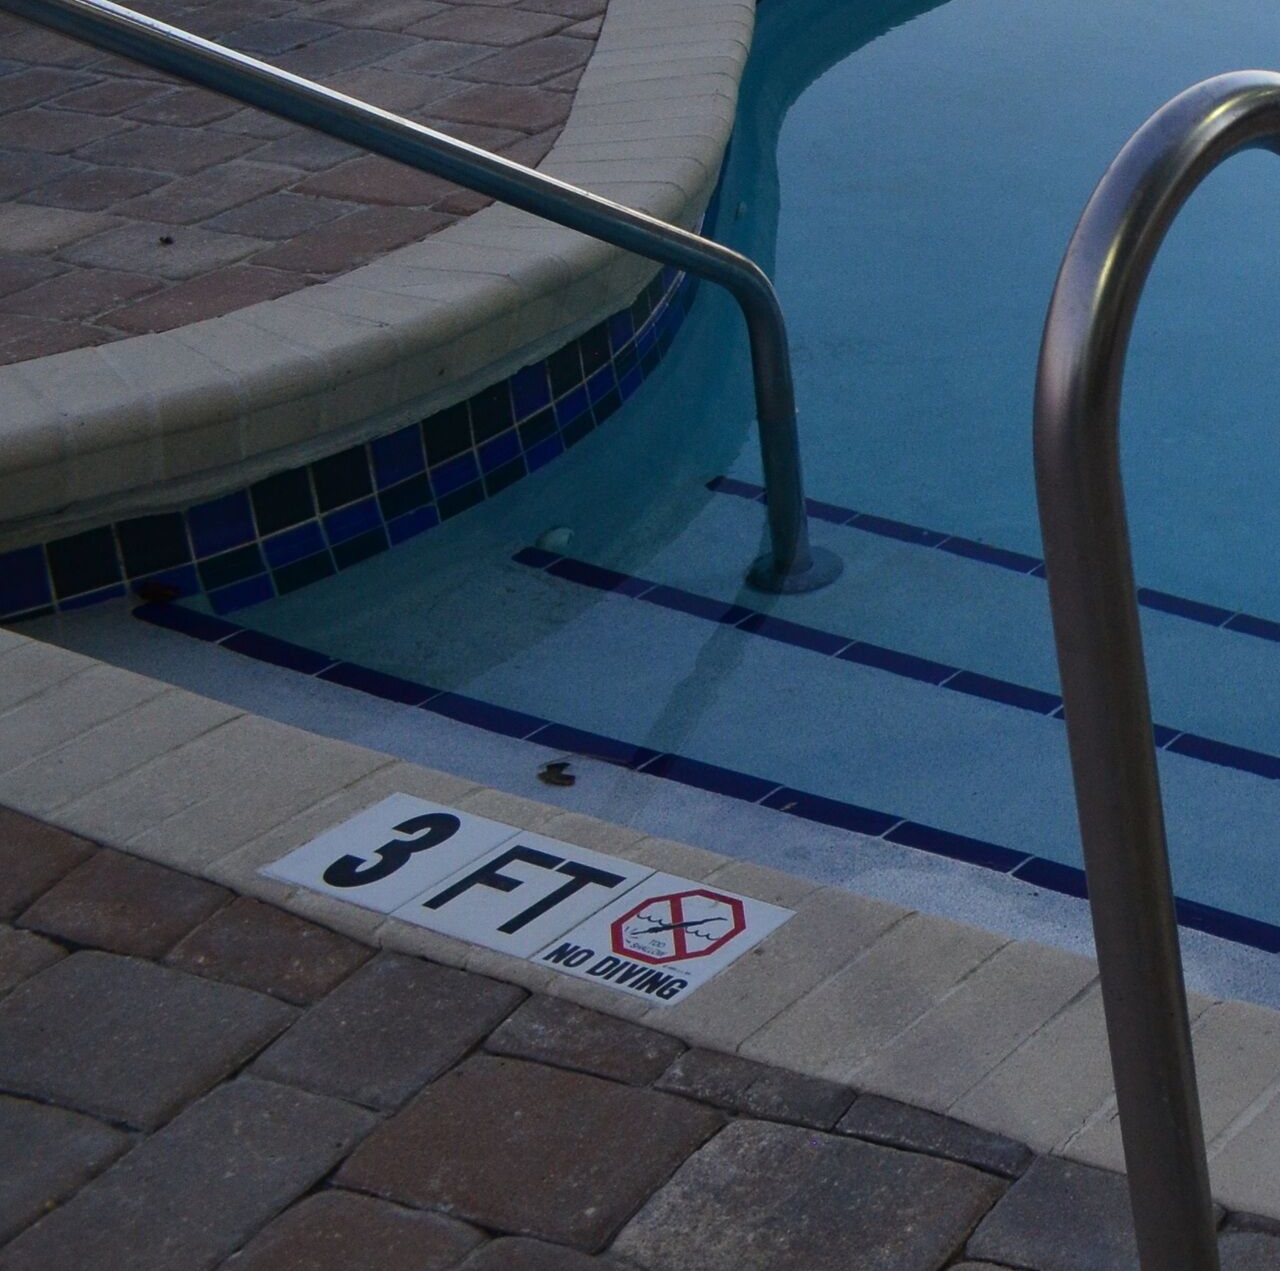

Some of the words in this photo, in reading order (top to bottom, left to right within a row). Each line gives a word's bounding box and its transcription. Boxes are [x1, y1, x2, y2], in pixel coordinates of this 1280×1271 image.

[322, 812, 461, 888] 3
[422, 845, 626, 935] FT
[542, 942, 595, 968] NO
[585, 955, 689, 1001] DIVING
